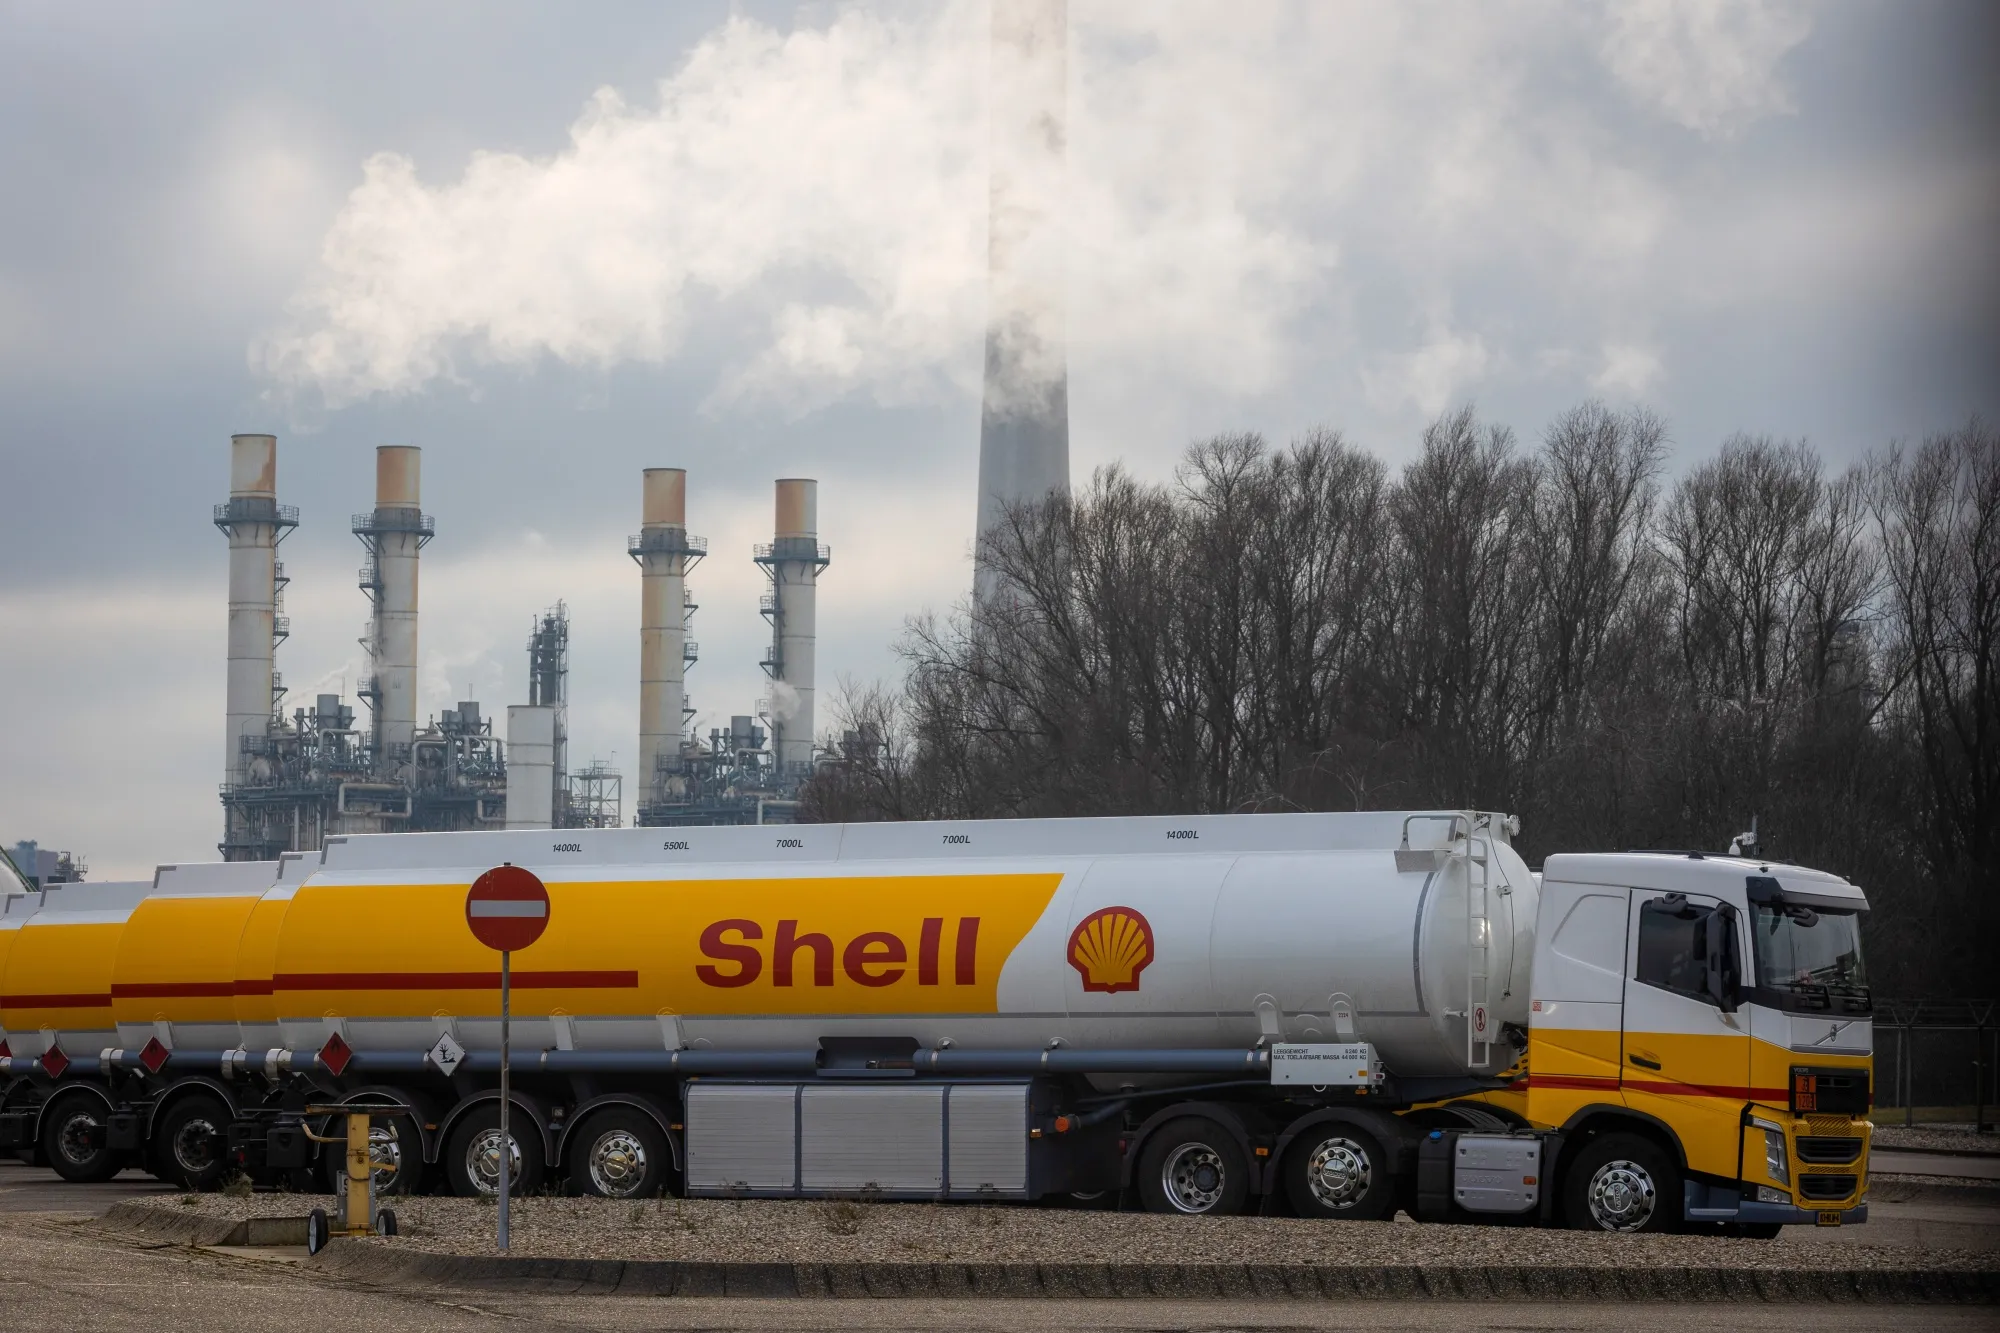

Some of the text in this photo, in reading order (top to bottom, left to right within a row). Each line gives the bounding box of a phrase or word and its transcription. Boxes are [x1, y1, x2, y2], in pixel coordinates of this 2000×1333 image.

[942, 834, 971, 844] 7000L
[1166, 830, 1200, 840] 14000L
[552, 843, 583, 852] 14000L
[663, 841, 690, 850] 5500L
[776, 838, 804, 848] 7000L
[695, 916, 981, 988] Shell
[1461, 1173, 1504, 1184] VOLVO
[1614, 1184, 1622, 1211] VOLVO
